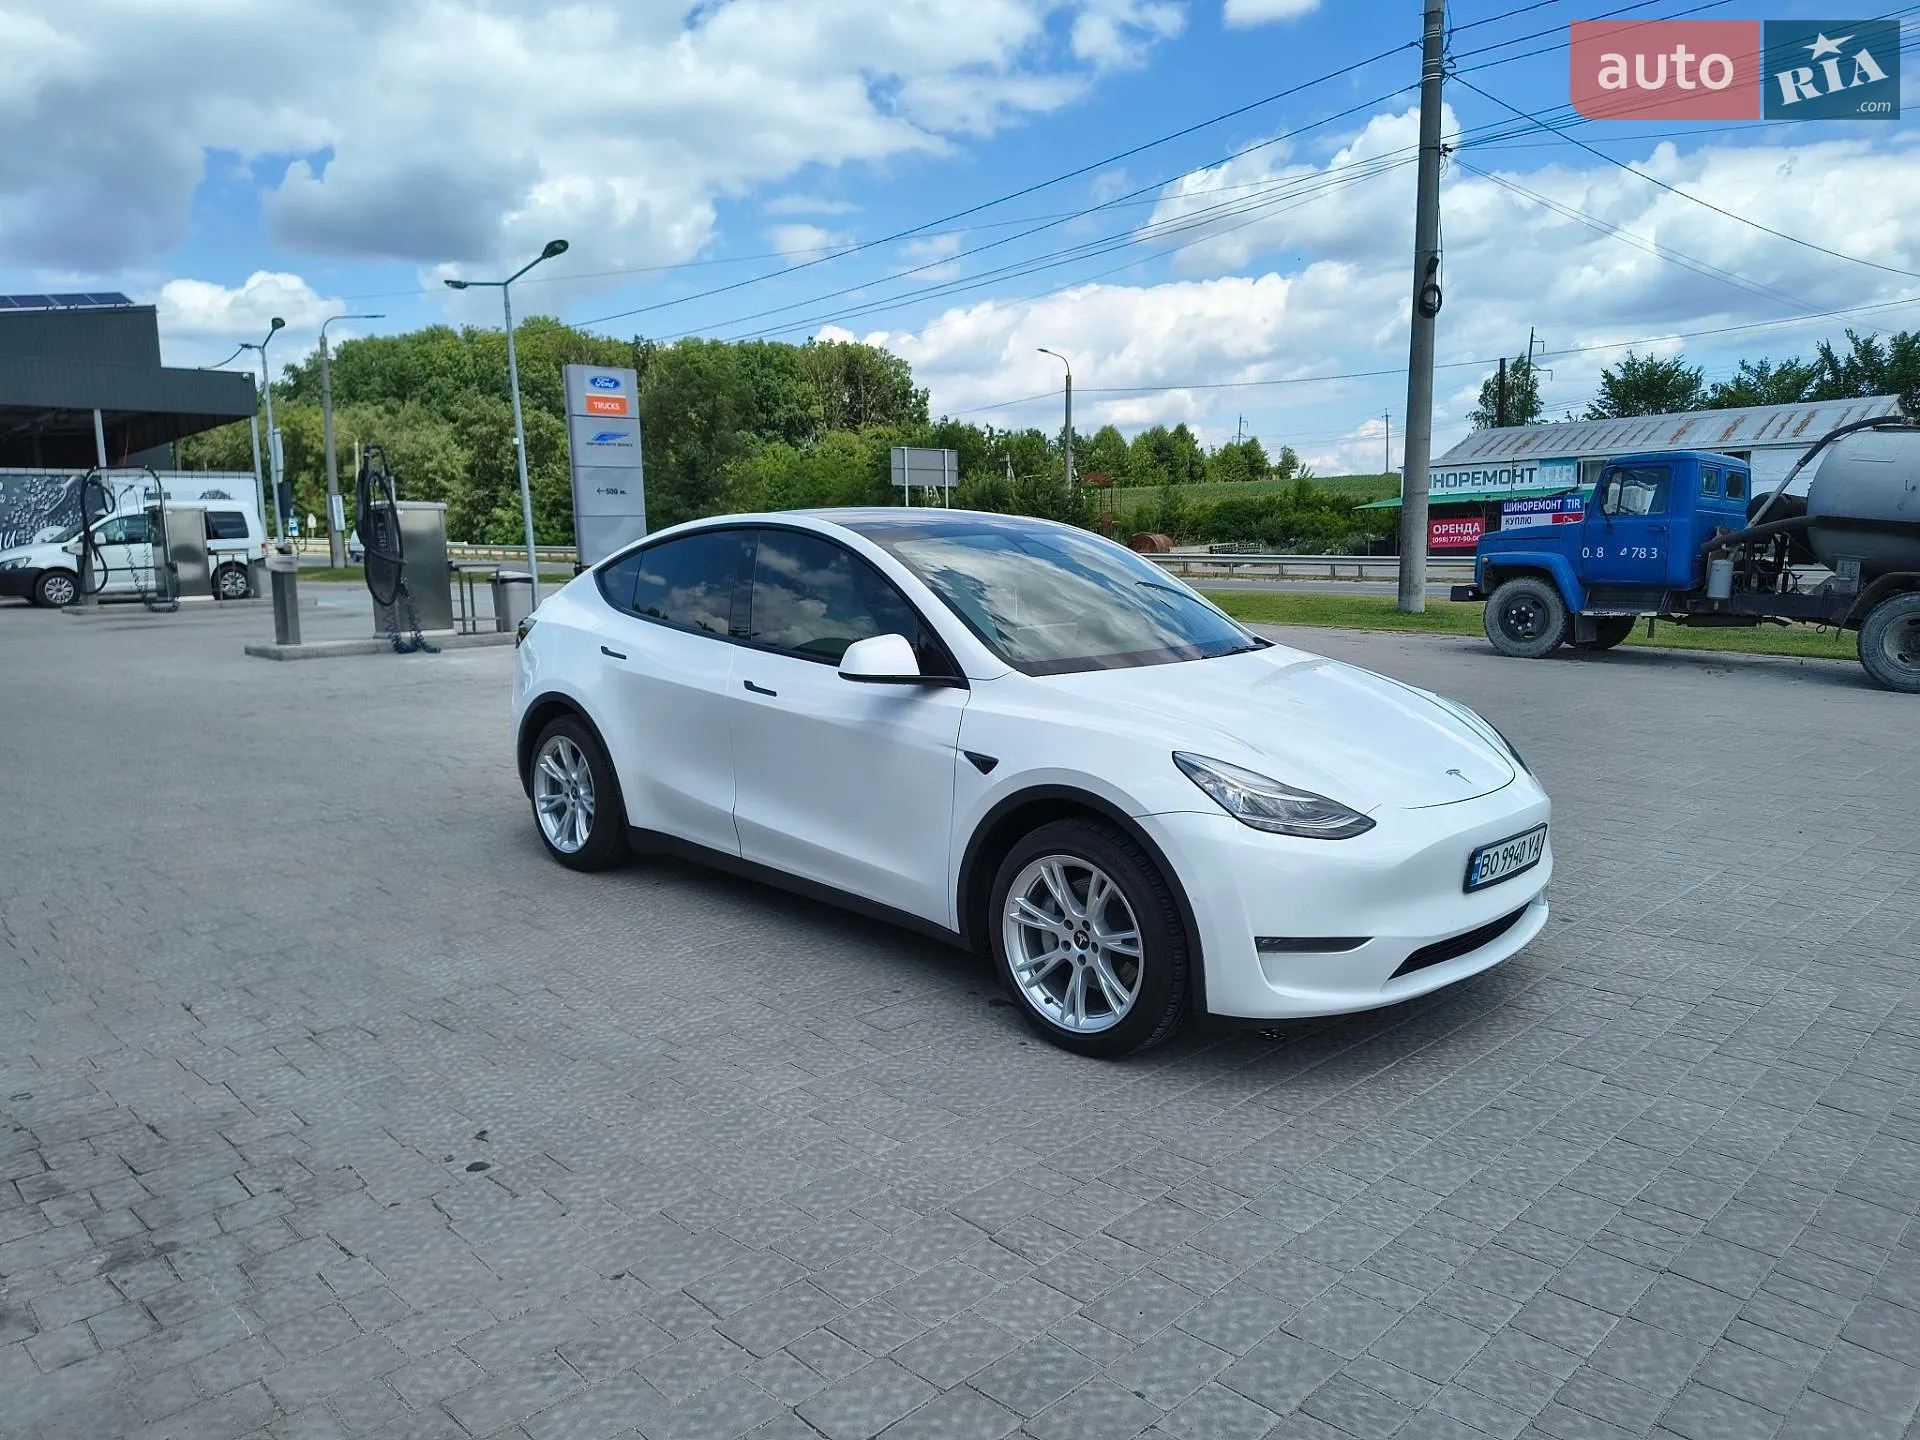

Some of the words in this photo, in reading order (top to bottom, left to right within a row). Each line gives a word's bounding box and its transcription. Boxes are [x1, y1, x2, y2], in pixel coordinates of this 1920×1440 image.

[595, 378, 615, 388] Ford
[593, 401, 620, 411] TRUCKS
[1503, 499, 1562, 513] ШИНОРЕМОНТ
[1566, 498, 1581, 509] TIR
[1505, 516, 1532, 526] КУПЛЮ
[1433, 522, 1480, 534] ОРЕНДА
[1480, 850, 1499, 879] BO
[1500, 840, 1526, 873] 9940
[1528, 833, 1541, 860] YA
